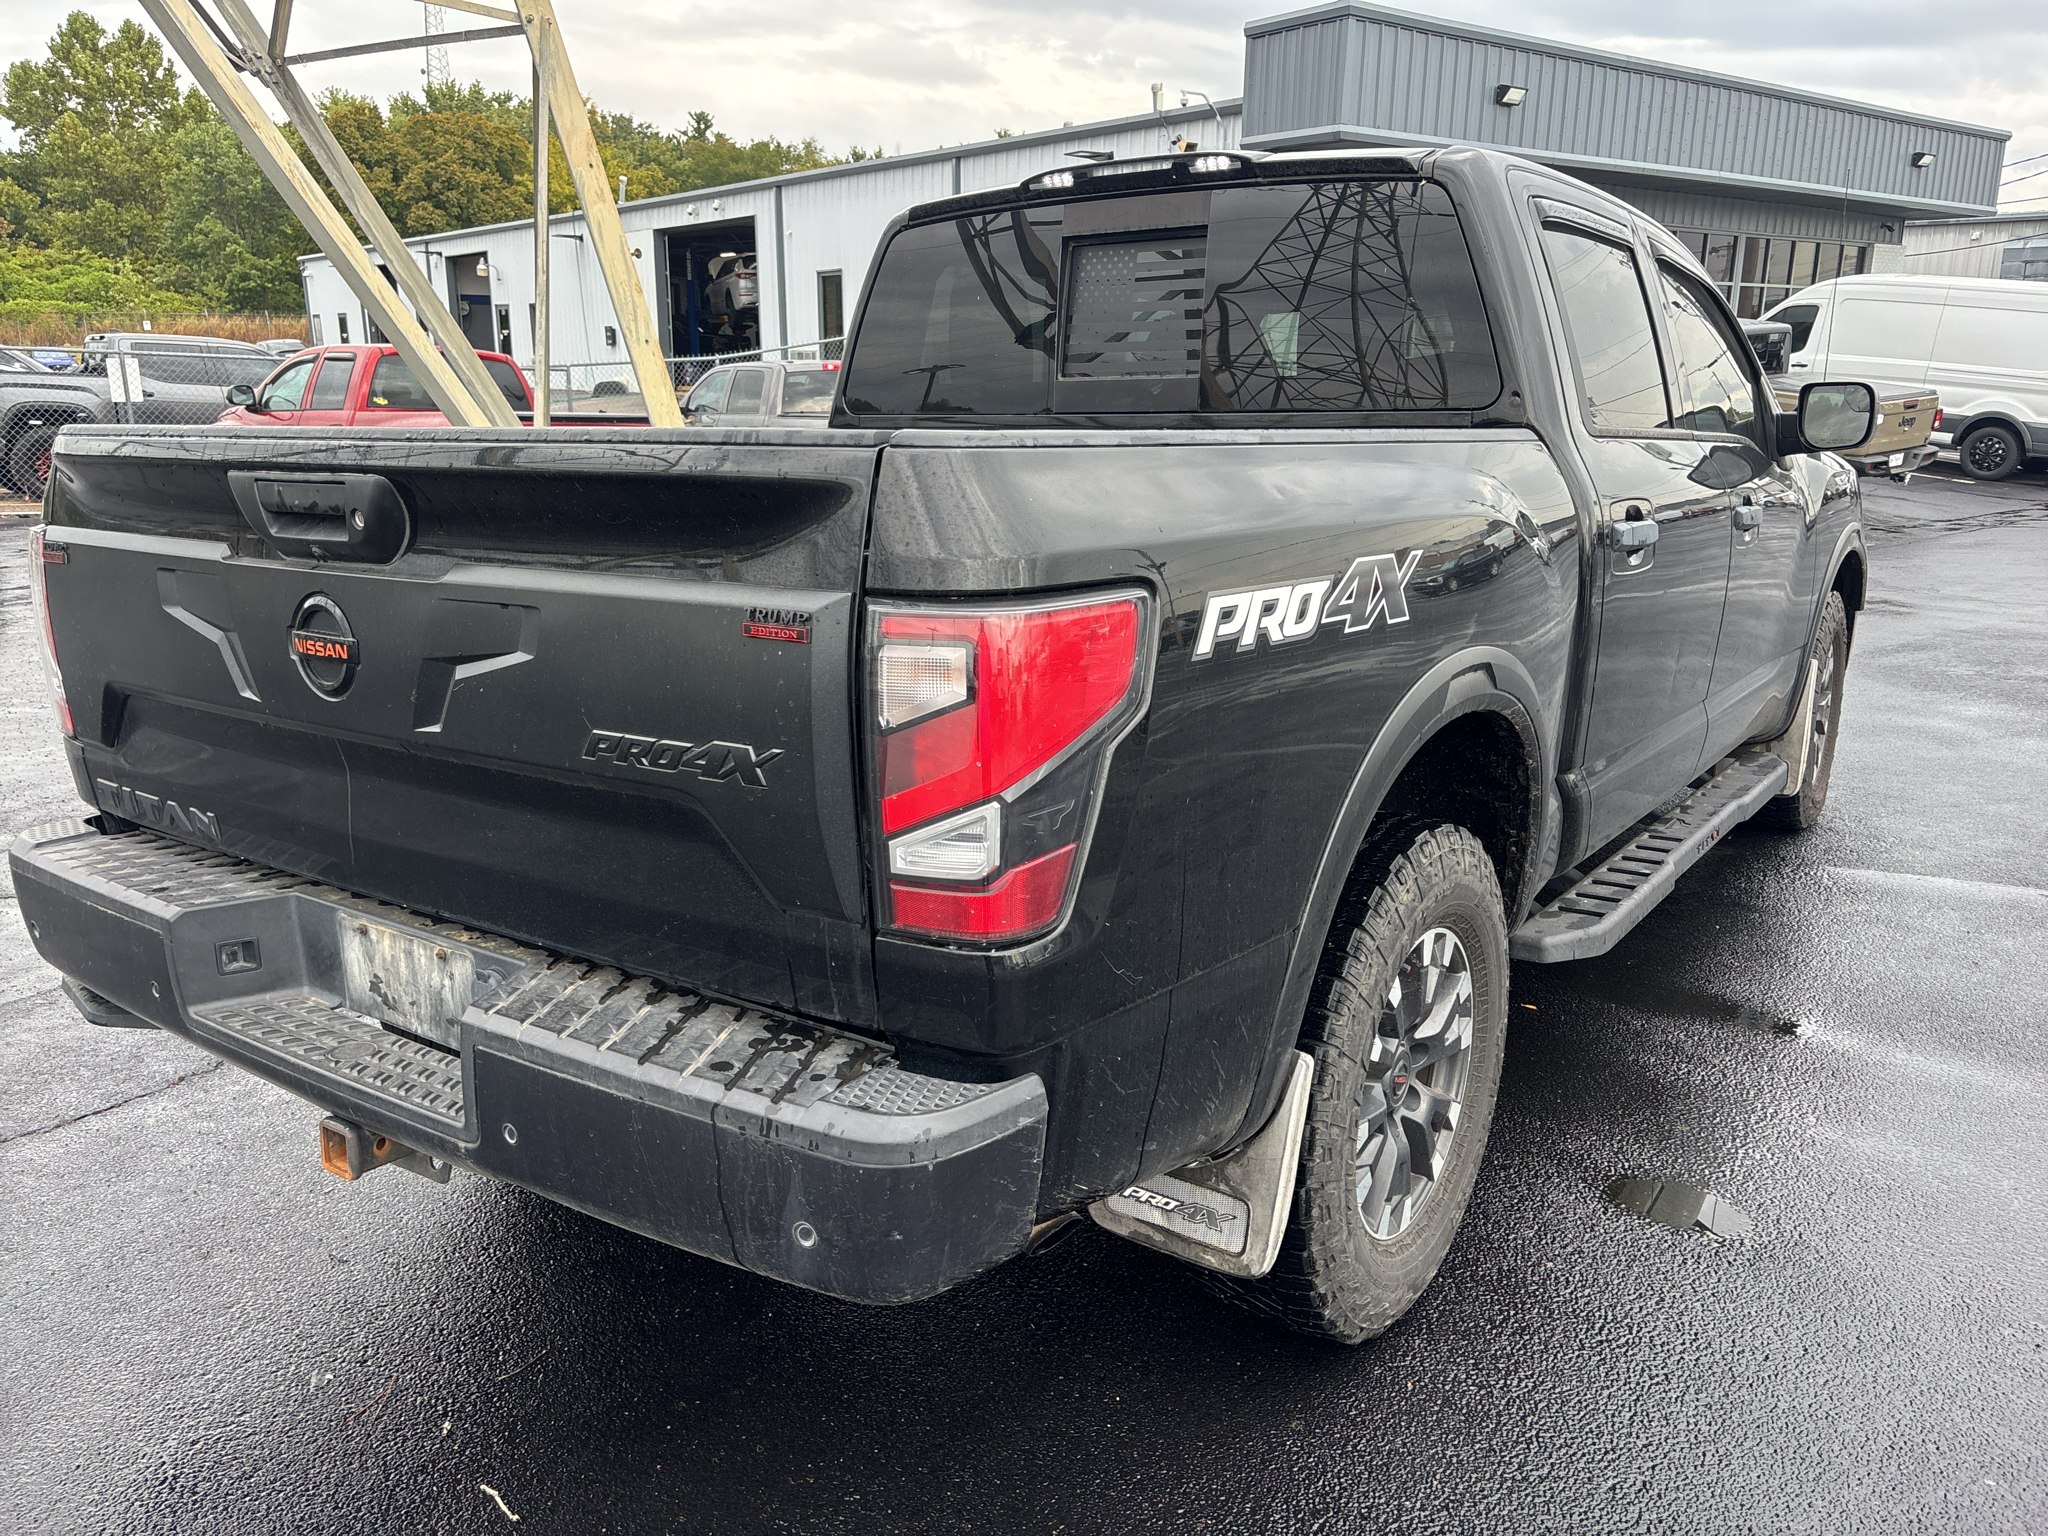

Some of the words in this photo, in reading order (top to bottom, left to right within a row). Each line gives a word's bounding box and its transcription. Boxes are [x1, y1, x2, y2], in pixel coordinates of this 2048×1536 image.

[1898, 415, 1916, 428] Jeep
[744, 606, 810, 626] TRUMP
[750, 626, 798, 639] EDITION
[294, 637, 348, 659] NISSAN
[97, 778, 222, 842] TITAN
